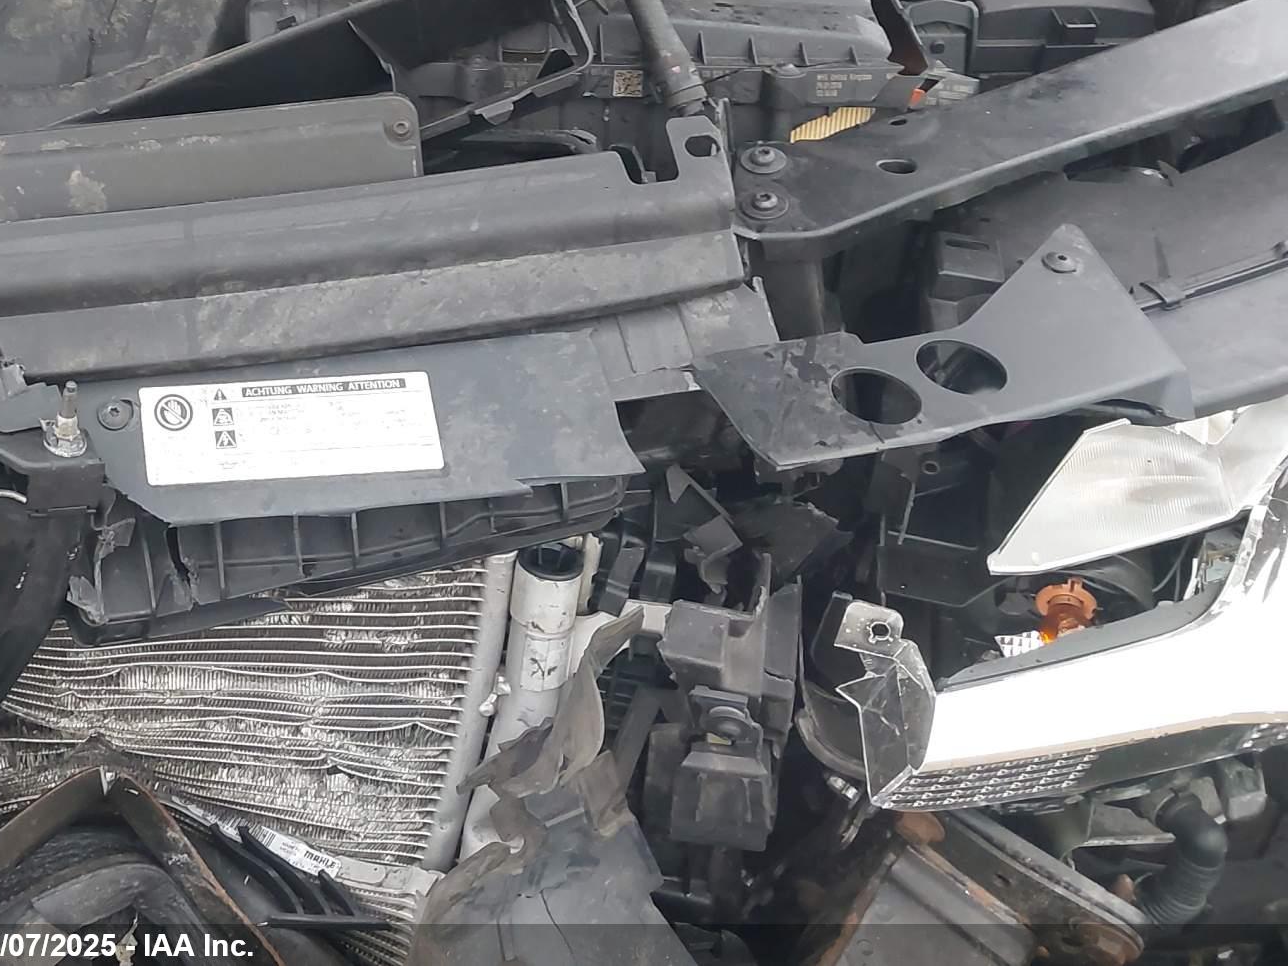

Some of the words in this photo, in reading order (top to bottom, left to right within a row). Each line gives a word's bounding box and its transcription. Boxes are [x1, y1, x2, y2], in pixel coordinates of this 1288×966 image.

[245, 386, 293, 397] ACHTUNG
[296, 383, 344, 394] WARNING
[348, 379, 400, 391] ATTENTION
[303, 850, 337, 869] MAHLE
